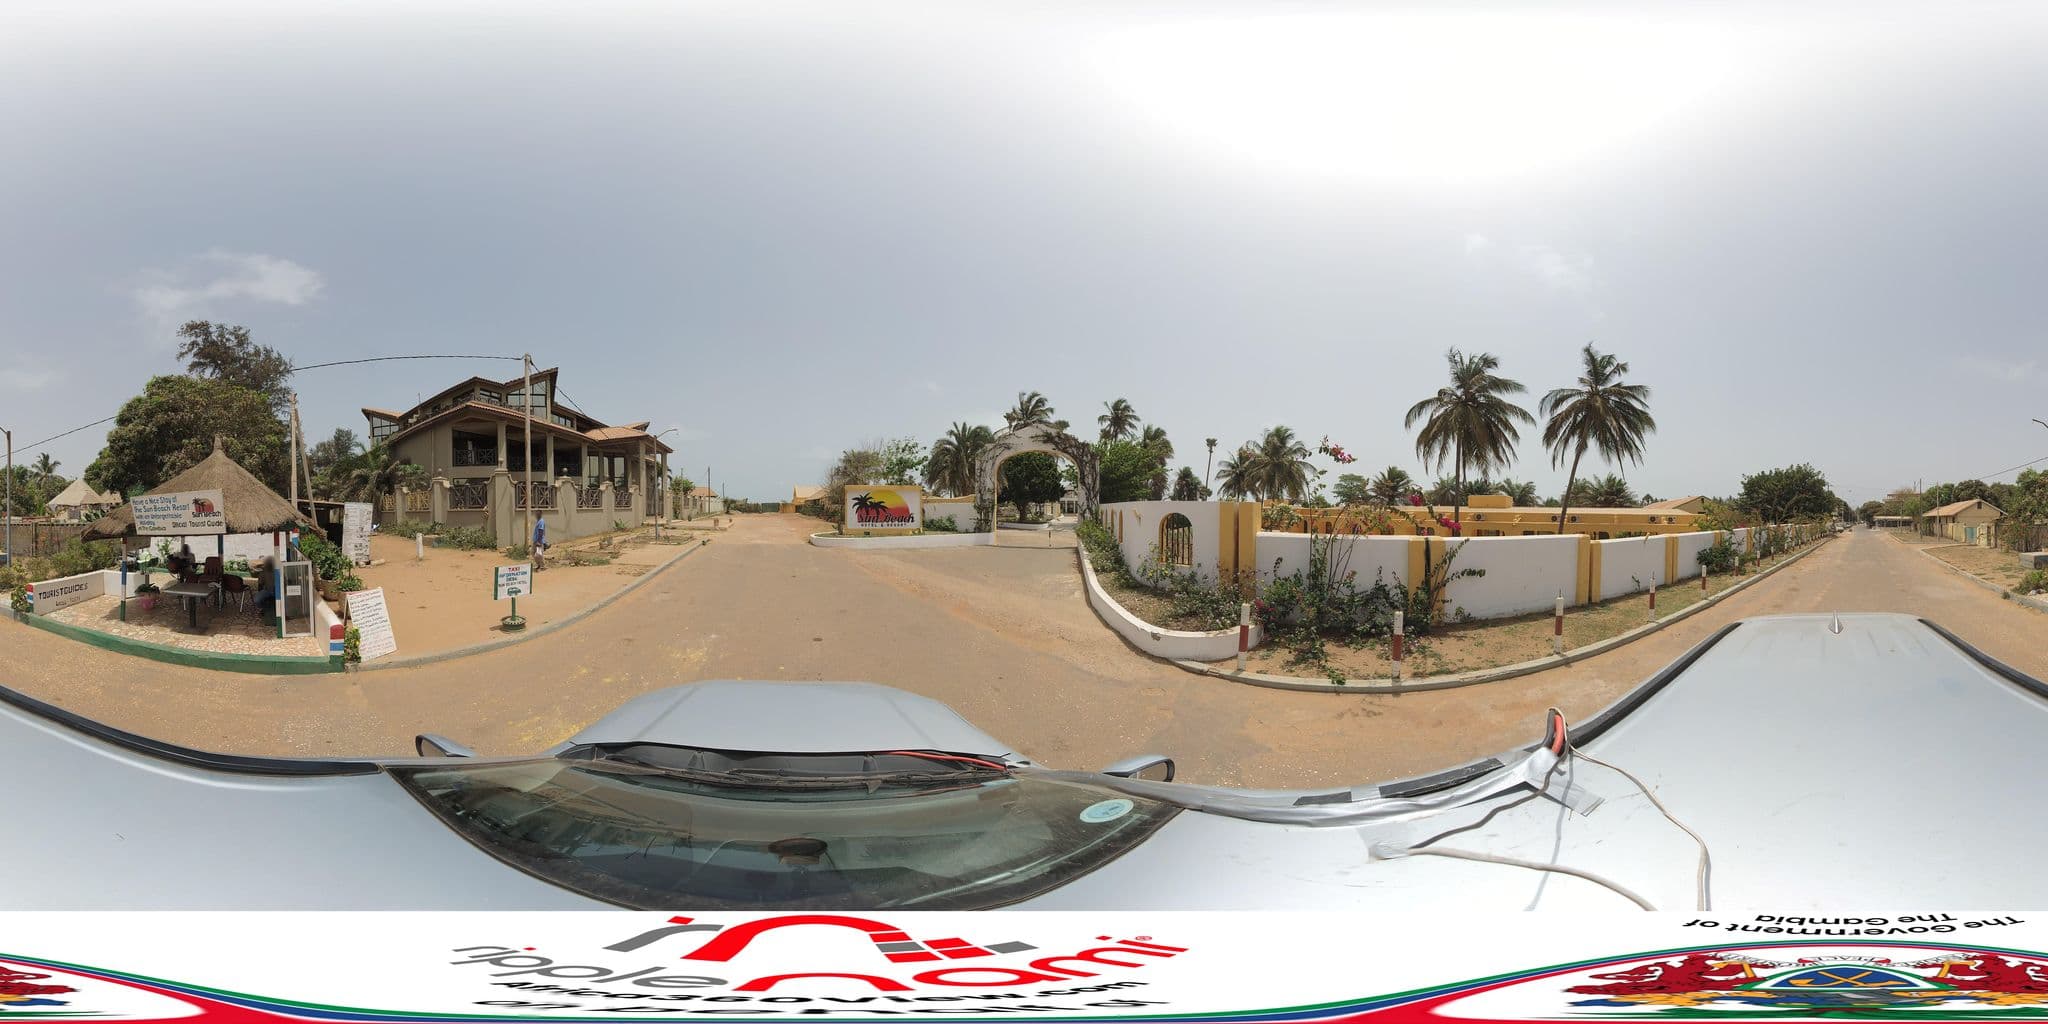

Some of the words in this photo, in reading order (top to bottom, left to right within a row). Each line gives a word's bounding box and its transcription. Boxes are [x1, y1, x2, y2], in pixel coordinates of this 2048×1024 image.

[858, 514, 879, 523] Sun
[884, 512, 915, 523] Beach
[38, 587, 64, 600] TOURIST
[64, 582, 88, 594] GUIDES
